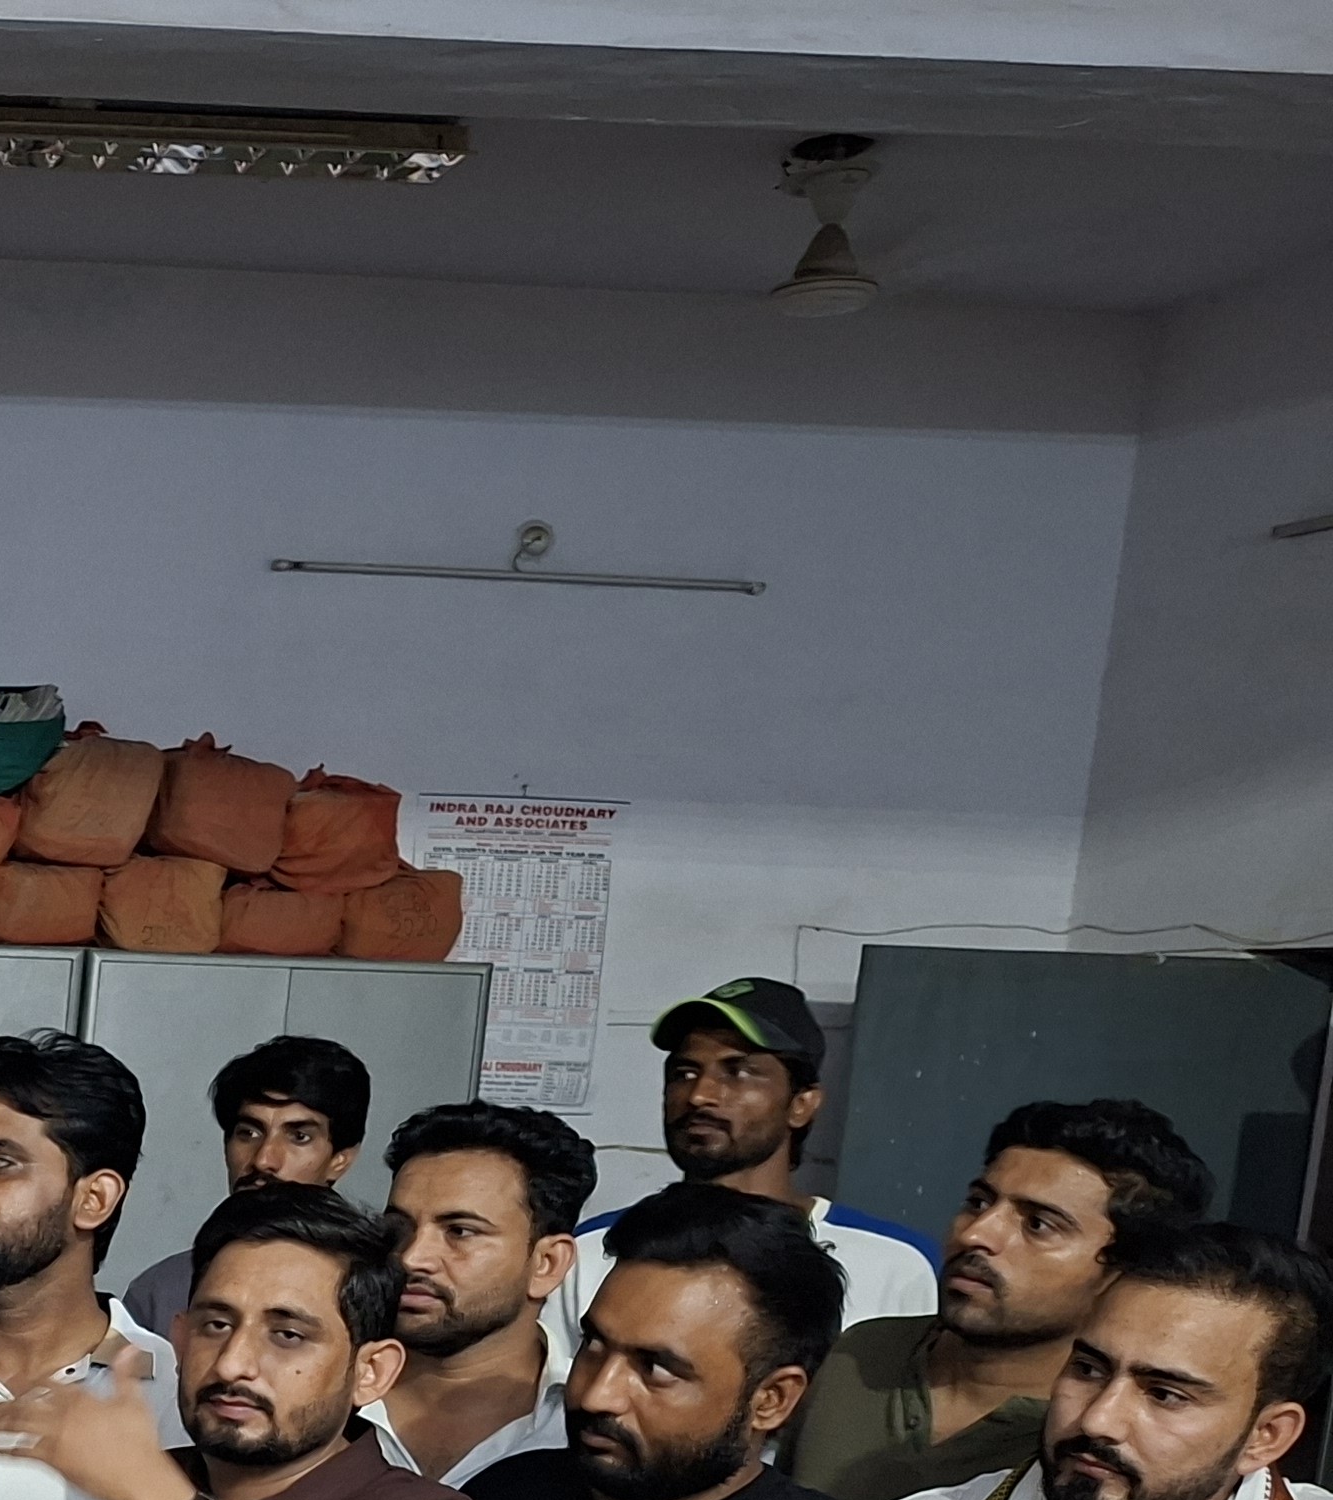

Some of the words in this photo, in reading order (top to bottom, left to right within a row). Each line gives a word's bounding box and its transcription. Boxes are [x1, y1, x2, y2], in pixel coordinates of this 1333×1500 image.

[429, 801, 479, 814] INDRA
[484, 803, 514, 815] RAJ
[520, 804, 618, 820] CHOUDHARY
[454, 815, 488, 827] AND
[493, 817, 589, 831] ASSOCIATES
